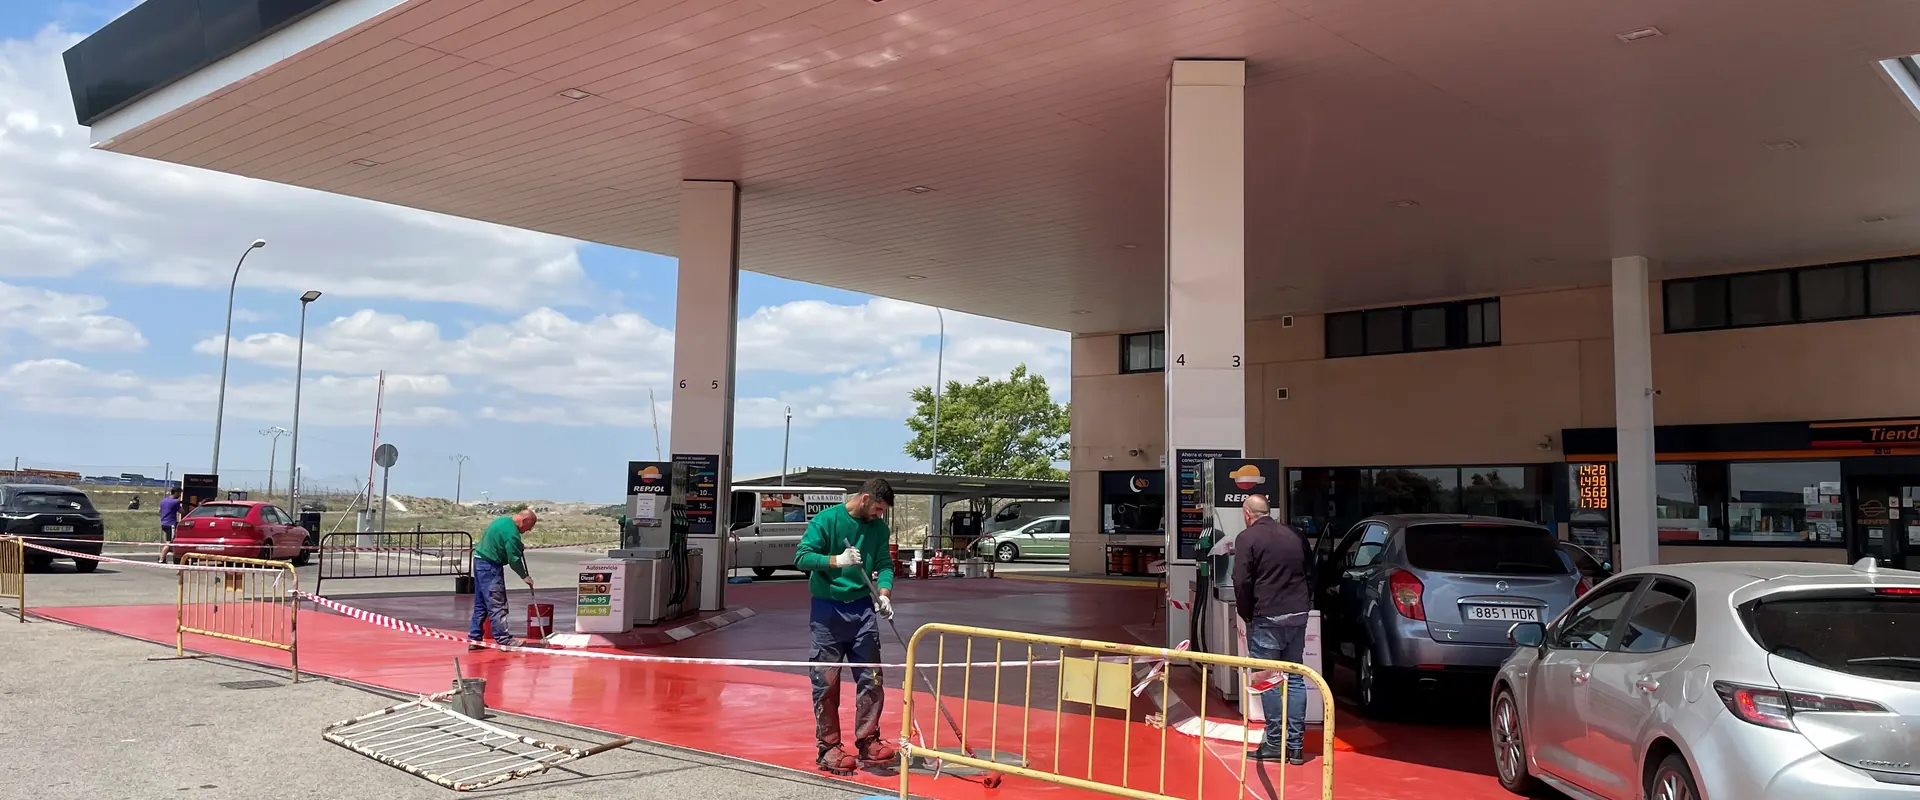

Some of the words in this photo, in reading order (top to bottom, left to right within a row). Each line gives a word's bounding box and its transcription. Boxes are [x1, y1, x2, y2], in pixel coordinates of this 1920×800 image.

[1176, 354, 1185, 366] 4
[1232, 355, 1241, 367] 3
[680, 379, 687, 389] 6
[711, 380, 718, 389] 5
[1870, 426, 1920, 440] Tiend
[1580, 464, 1606, 476] 1.428
[1580, 475, 1607, 487] 1.498
[1580, 486, 1607, 498] 1.568
[1581, 498, 1608, 509] 1.738
[1476, 607, 1507, 619] 8851
[1511, 609, 1536, 620] HDK
